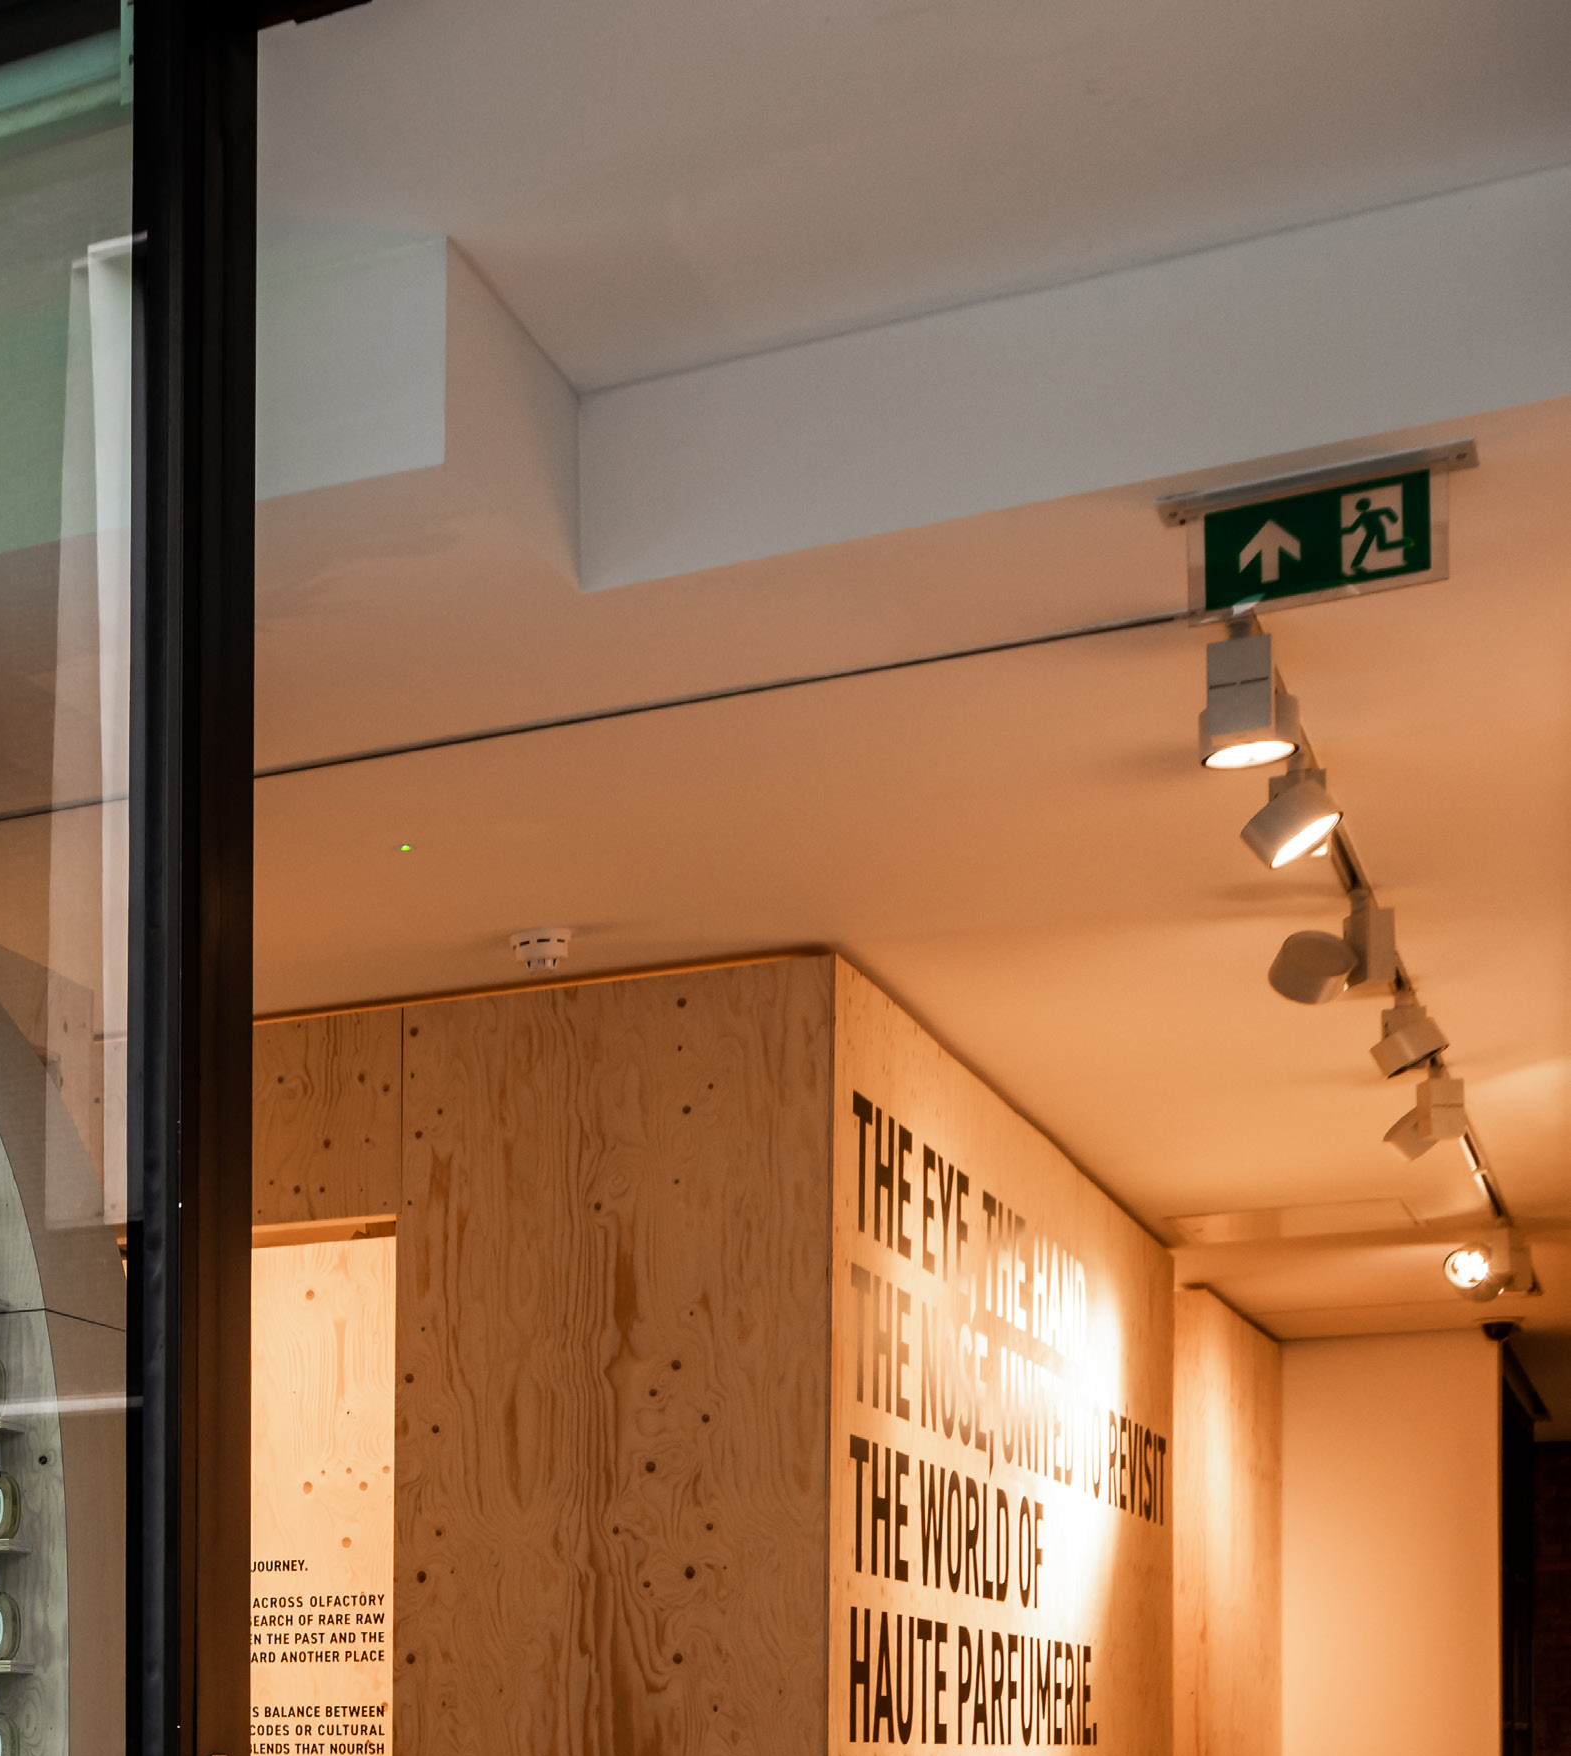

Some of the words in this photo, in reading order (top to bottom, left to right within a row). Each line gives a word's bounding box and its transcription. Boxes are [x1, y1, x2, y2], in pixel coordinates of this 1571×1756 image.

[852, 1089, 912, 1260] THE
[982, 1189, 1027, 1332] THE
[850, 1262, 911, 1421] THE
[1107, 1409, 1167, 1526] REVISIT
[849, 1434, 910, 1583] THE
[918, 1459, 1009, 1602] WORLD
[1018, 1495, 1044, 1609] OF
[251, 1559, 309, 1573] JOURNEY.
[252, 1596, 304, 1609] ACROSS
[309, 1594, 385, 1608] OLFACTORY
[250, 1614, 294, 1627] EARCH
[298, 1614, 314, 1626] OF
[318, 1613, 351, 1625] RARE
[356, 1613, 385, 1625] RAW
[266, 1633, 290, 1645] THE
[294, 1632, 326, 1645] PAST
[330, 1632, 356, 1644] AND
[361, 1631, 385, 1643] THE
[280, 1650, 340, 1663] ANOTHER
[345, 1650, 385, 1662] PLACE
[849, 1606, 948, 1745] HAUTE
[957, 1625, 1098, 1747] PARFUMERIE.
[264, 1706, 321, 1718] BALANCE
[325, 1705, 385, 1718] BETWEEN
[250, 1724, 290, 1736] CODES
[295, 1724, 312, 1736] OR
[317, 1724, 385, 1736] CULTURAL
[295, 1743, 326, 1755] THAT
[329, 1743, 385, 1755] NOURISH
